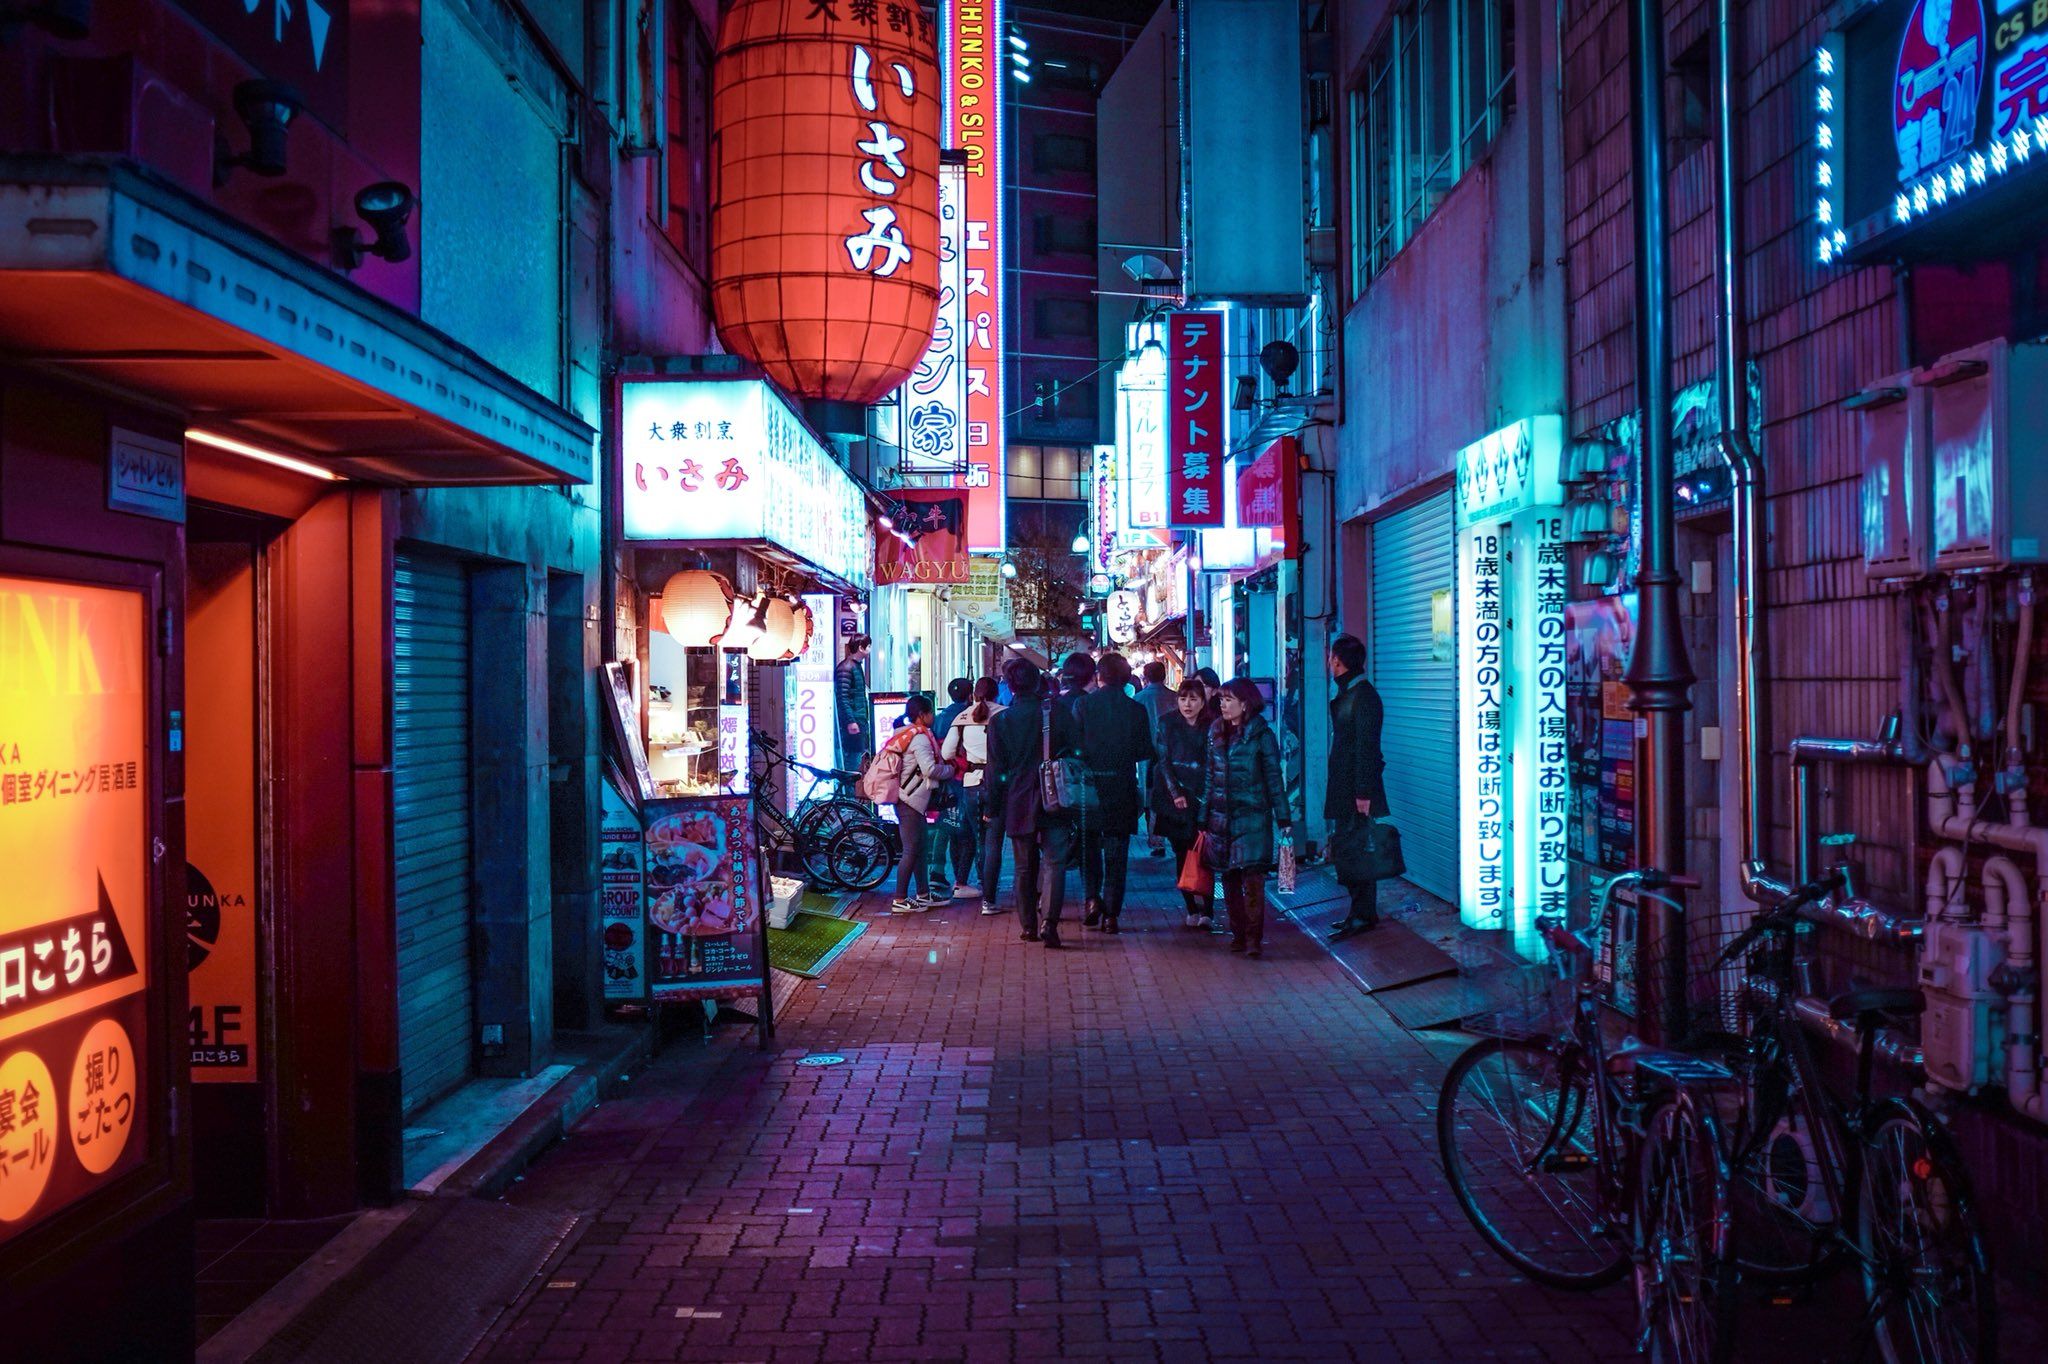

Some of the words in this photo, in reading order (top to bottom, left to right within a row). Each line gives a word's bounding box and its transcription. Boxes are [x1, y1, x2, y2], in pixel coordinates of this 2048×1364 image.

[846, 44, 916, 277] いさみ
[648, 420, 735, 441] 大衆割烹
[1182, 321, 1212, 517] テナント募集
[635, 458, 750, 492] いさみ
[1139, 511, 1160, 523] B1
[879, 561, 966, 580] WAGYU
[1473, 535, 1502, 921] 18歳未満の方の入場はお断り致します。
[86, 1046, 120, 1098] 掘り
[76, 1092, 132, 1147] ごたつ
